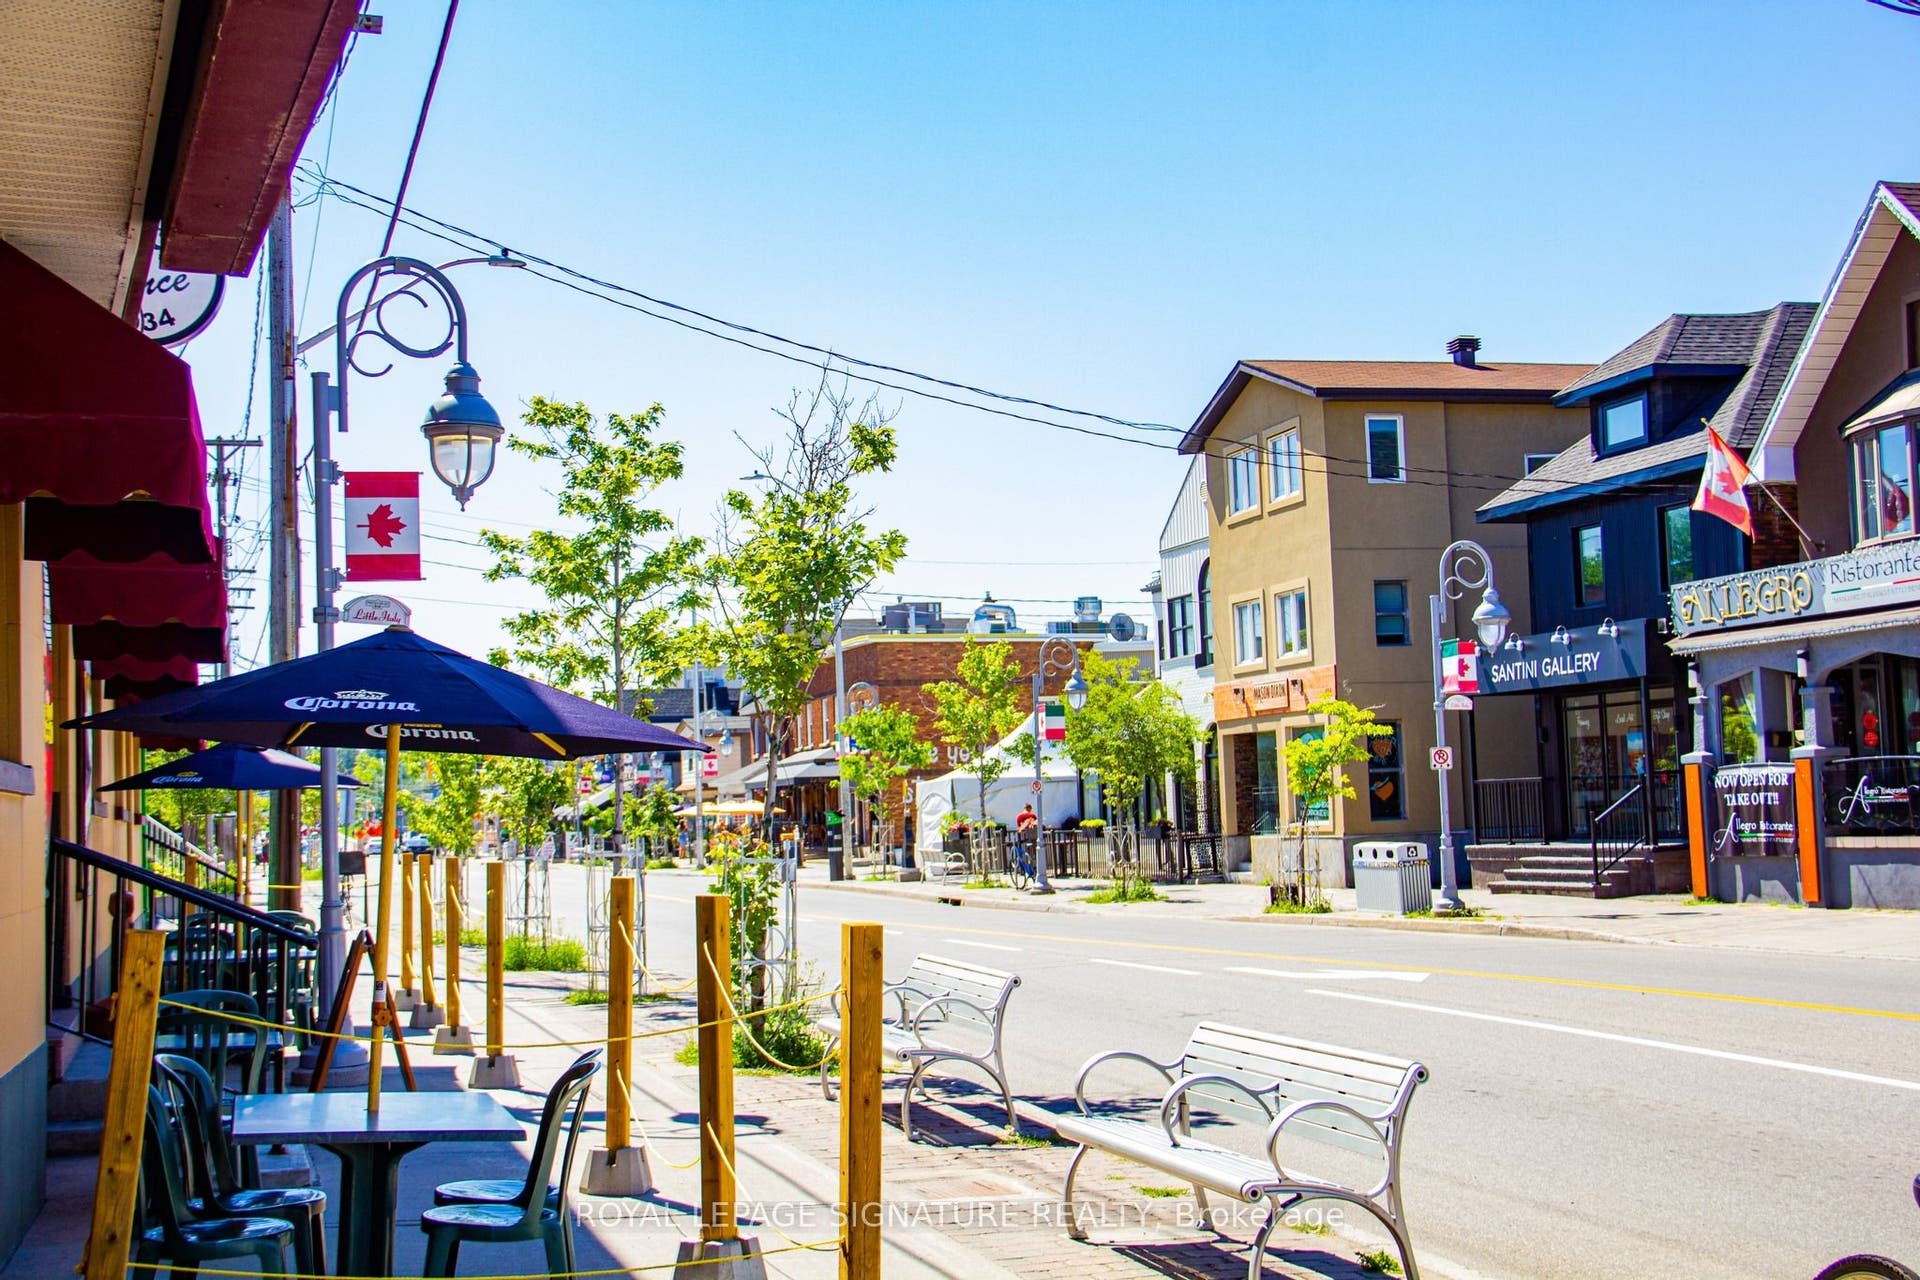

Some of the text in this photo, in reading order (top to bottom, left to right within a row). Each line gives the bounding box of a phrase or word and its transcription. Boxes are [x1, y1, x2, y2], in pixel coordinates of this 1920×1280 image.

[1681, 572, 1813, 626] ALLEGRO
[1491, 651, 1600, 683] SANTINI GALLERY
[284, 696, 416, 712] Corona
[1714, 772, 1789, 788] NOW OPEN FOR
[1724, 792, 1779, 806] TAKE OUT!!
